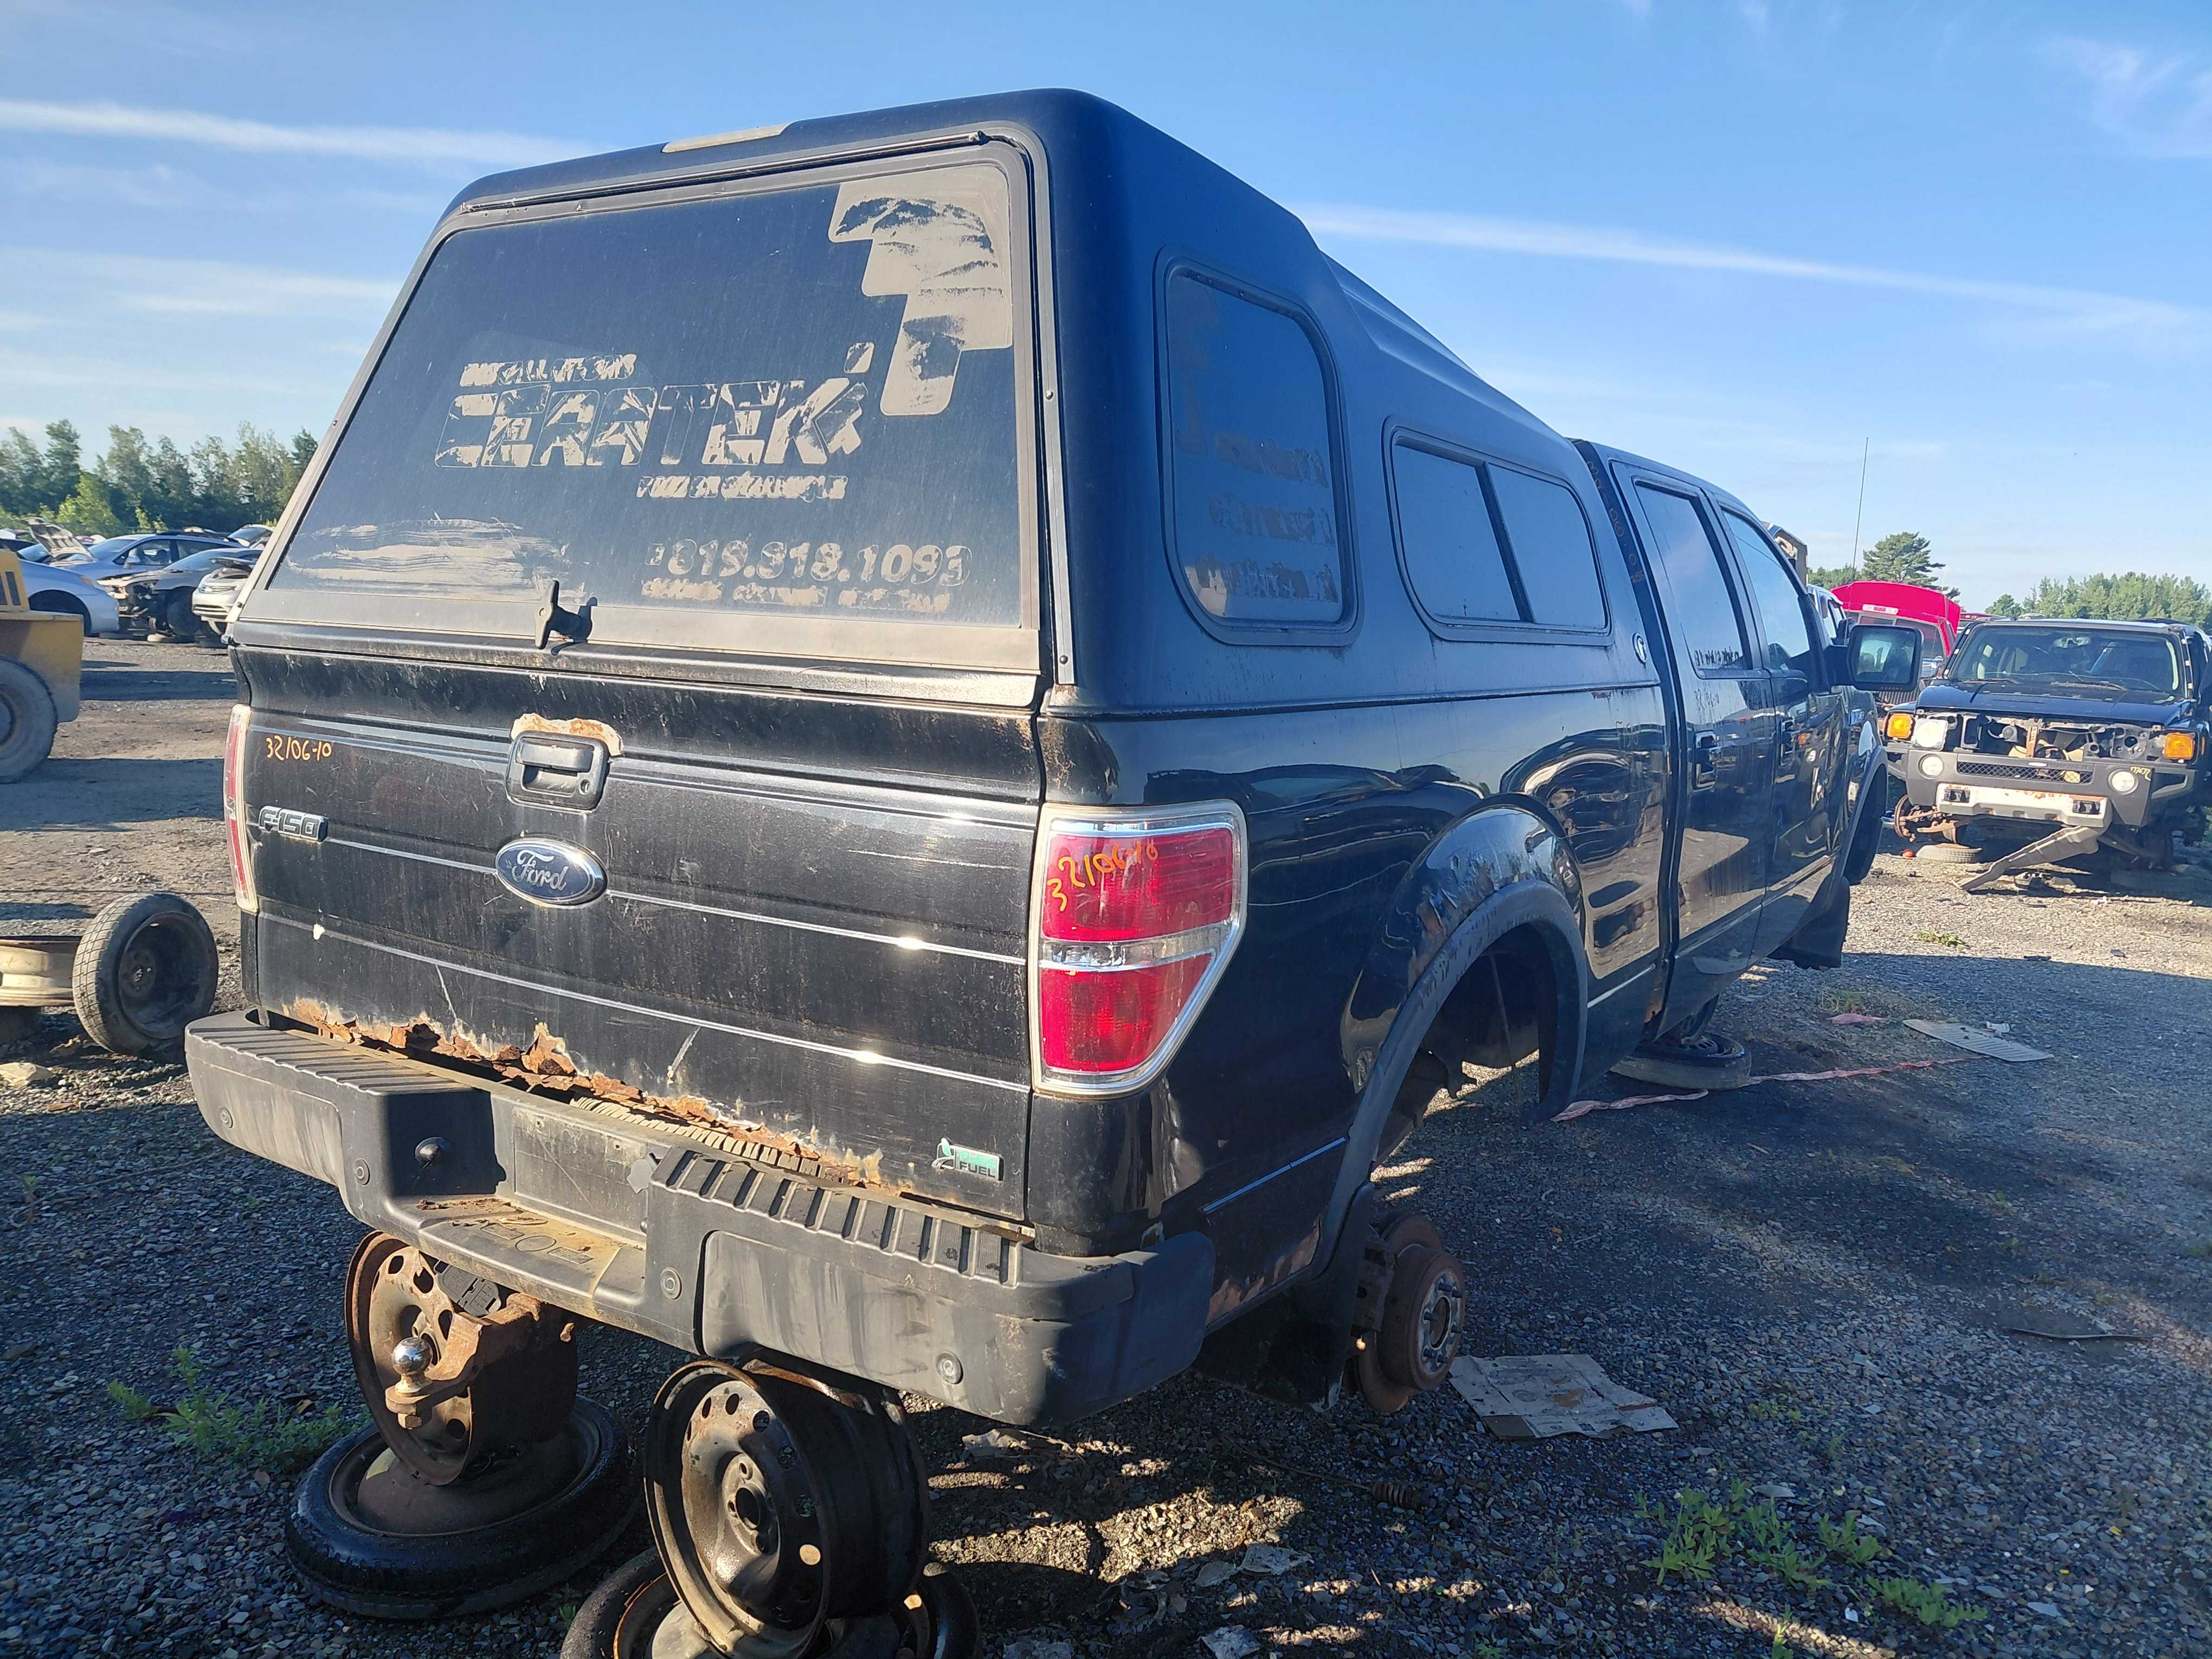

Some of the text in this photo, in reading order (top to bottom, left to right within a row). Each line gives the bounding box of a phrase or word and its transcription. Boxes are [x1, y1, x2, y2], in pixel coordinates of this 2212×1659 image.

[266, 735, 332, 761] 32106-10
[259, 806, 321, 840] F-150
[511, 850, 569, 891] Ford
[1047, 841, 1158, 911] 32106-10
[959, 1161, 996, 1178] FUEL
